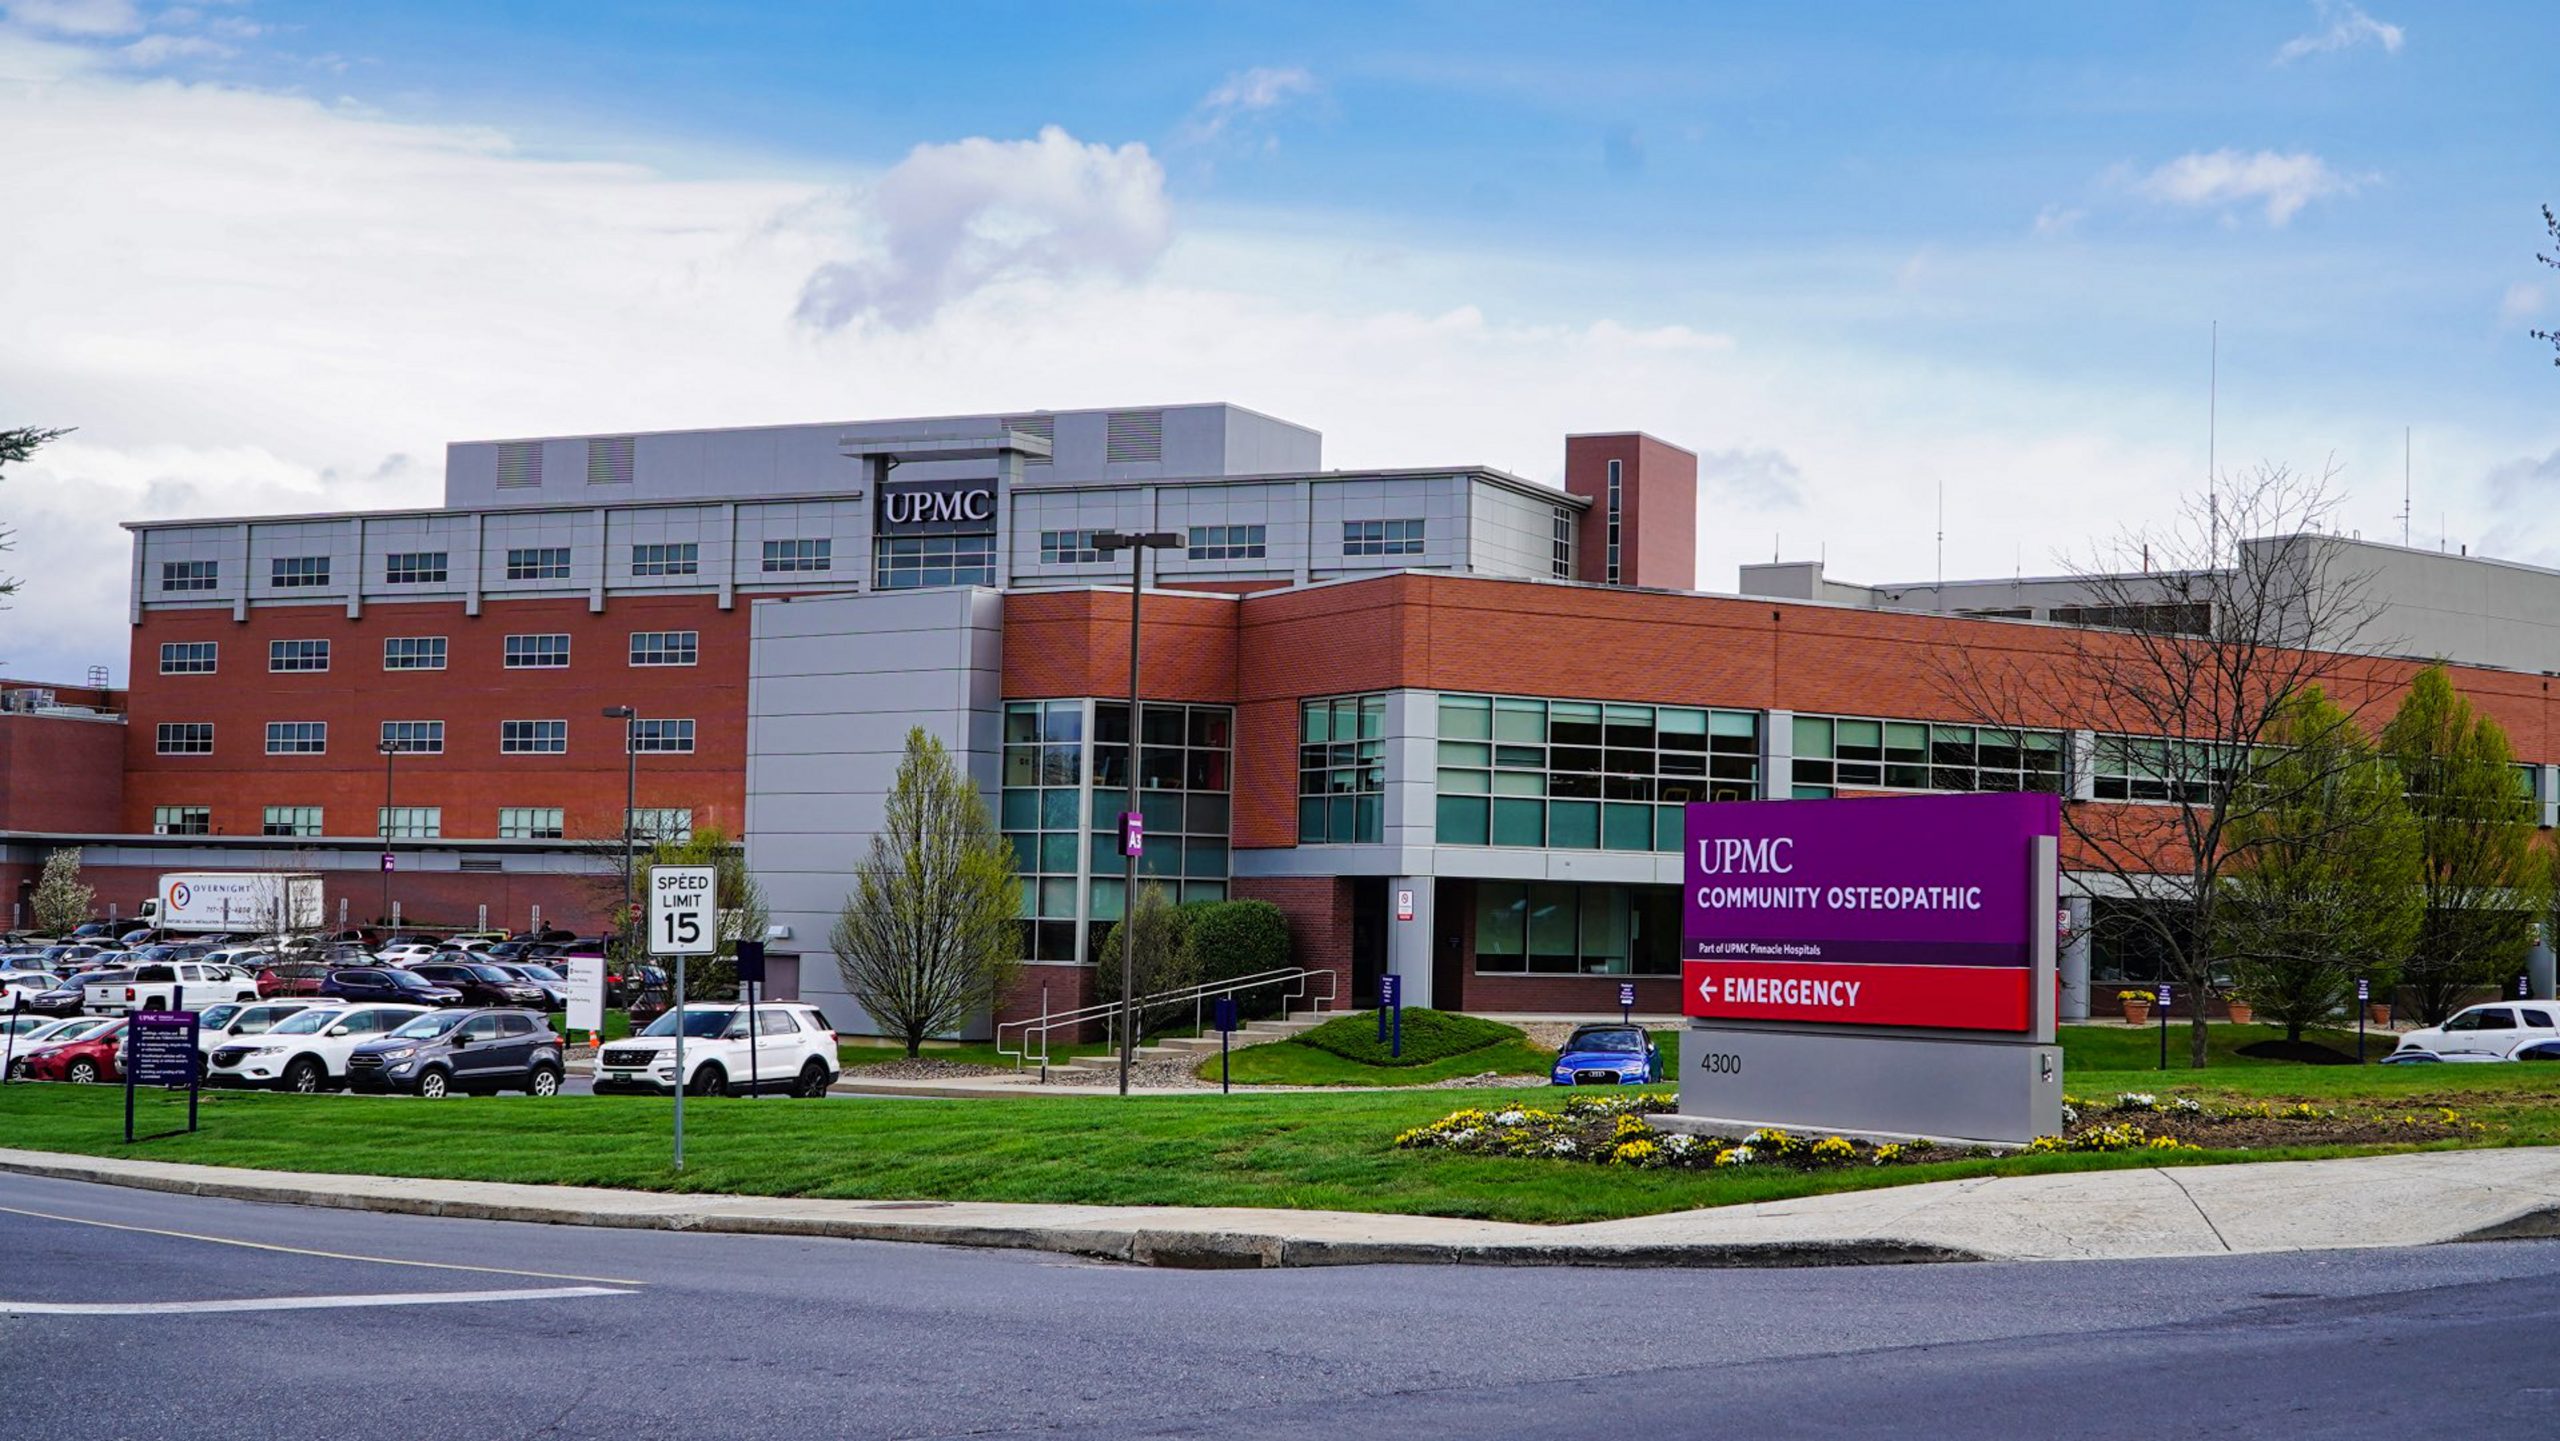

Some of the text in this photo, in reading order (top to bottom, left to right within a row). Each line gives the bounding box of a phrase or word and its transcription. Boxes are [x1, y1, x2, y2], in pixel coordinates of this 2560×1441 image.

[885, 489, 992, 524] UPMC
[1129, 830, 1142, 849] A3
[1698, 837, 1793, 875] UPMC
[193, 884, 251, 893] OVERNIGHT
[657, 876, 709, 890] SPEED
[663, 894, 702, 908] LIMIT
[1698, 887, 1981, 910] COMMUNITY OSTEOPATHIC
[664, 912, 701, 944] 15
[1698, 943, 1822, 957] Part of UPMC Pinnacle Hospitals
[1724, 977, 1861, 1007] EMERGENCY
[1701, 1053, 1742, 1075] 4300
